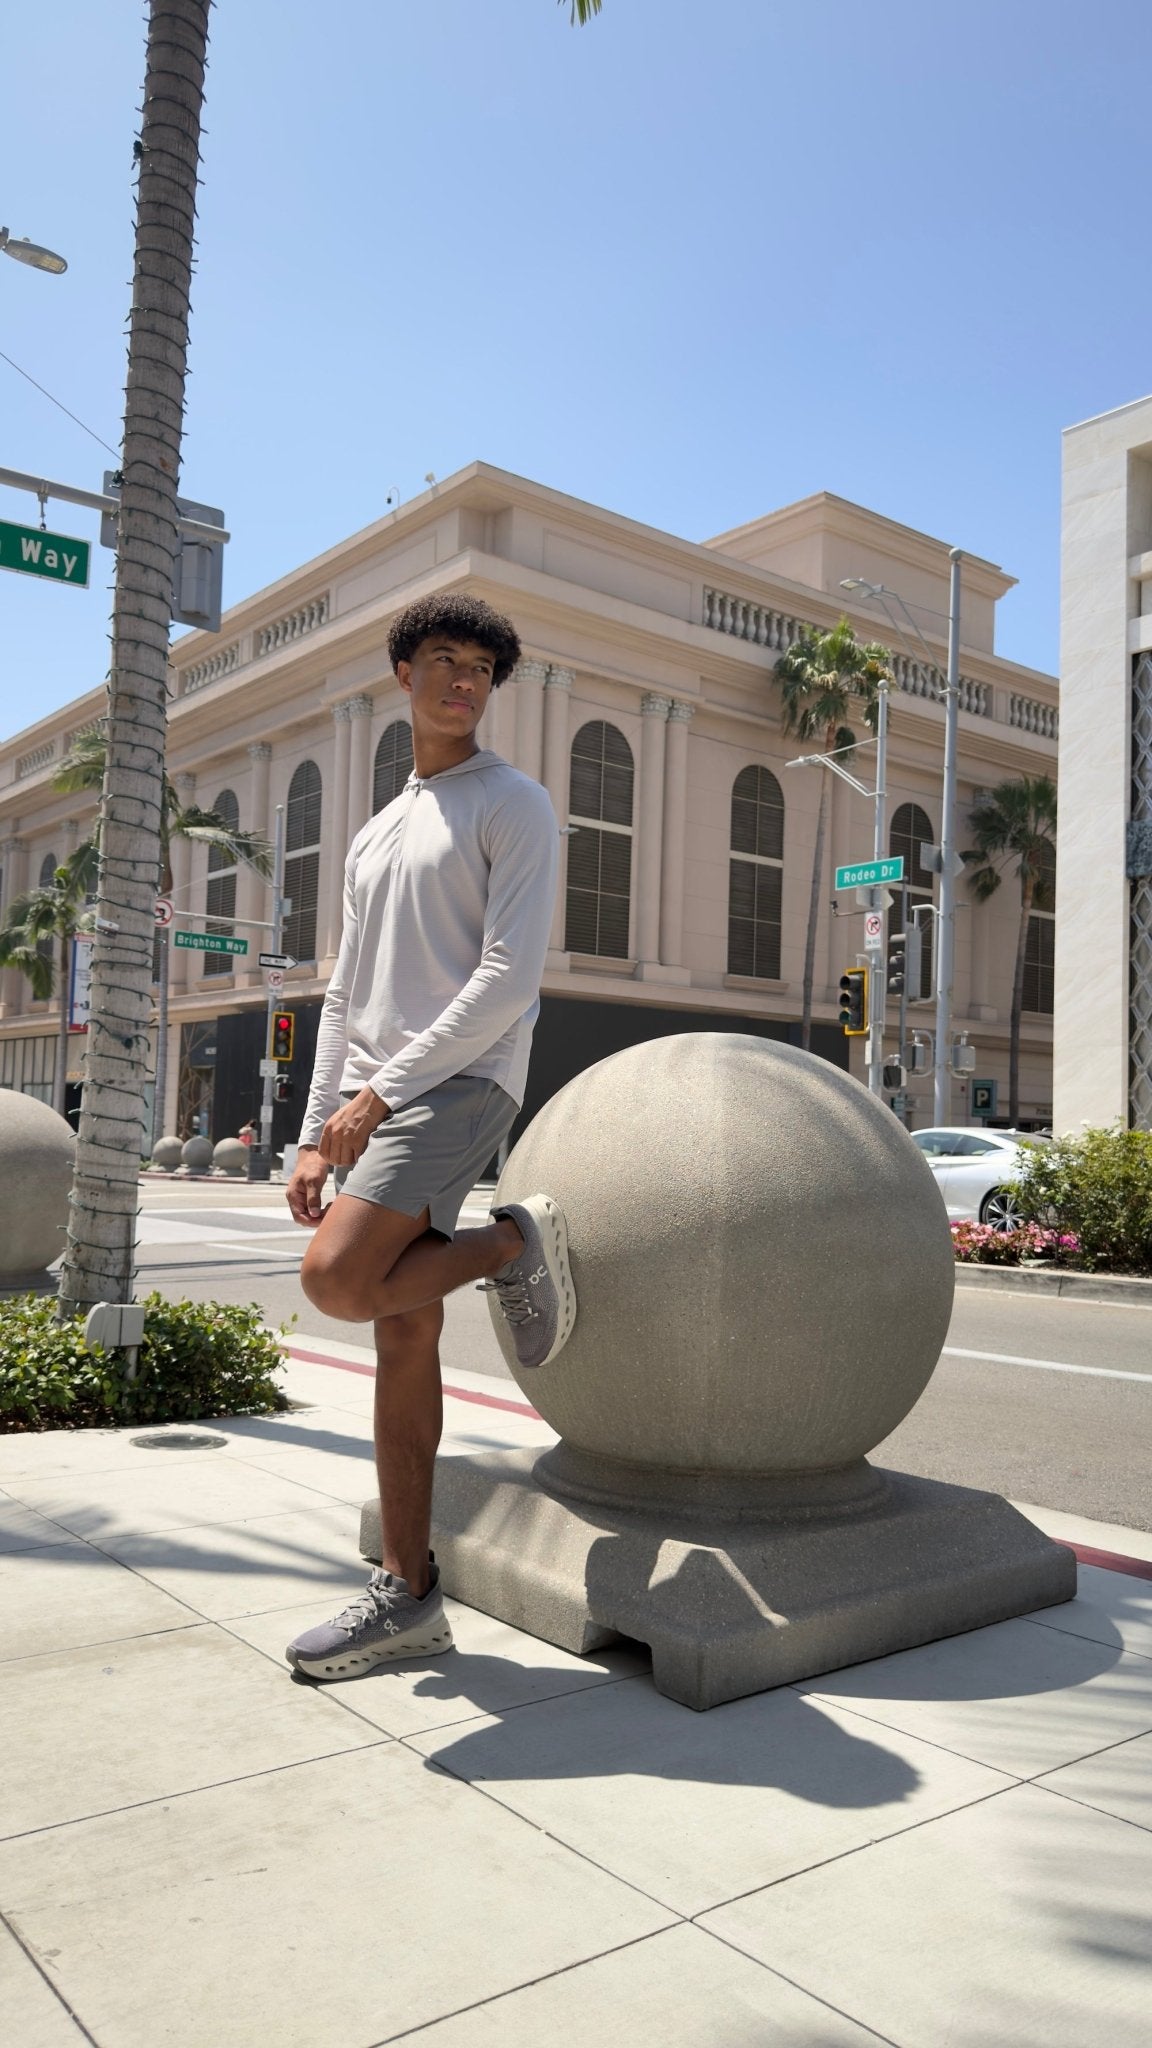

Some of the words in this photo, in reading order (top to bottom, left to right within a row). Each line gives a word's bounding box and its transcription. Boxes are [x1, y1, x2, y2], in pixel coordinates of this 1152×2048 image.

[21, 537, 78, 577] Way
[843, 870, 876, 883] Rodeo
[881, 865, 894, 877] Dr
[177, 935, 221, 948] Brighton
[226, 941, 245, 953] Way
[976, 1089, 989, 1106] P
